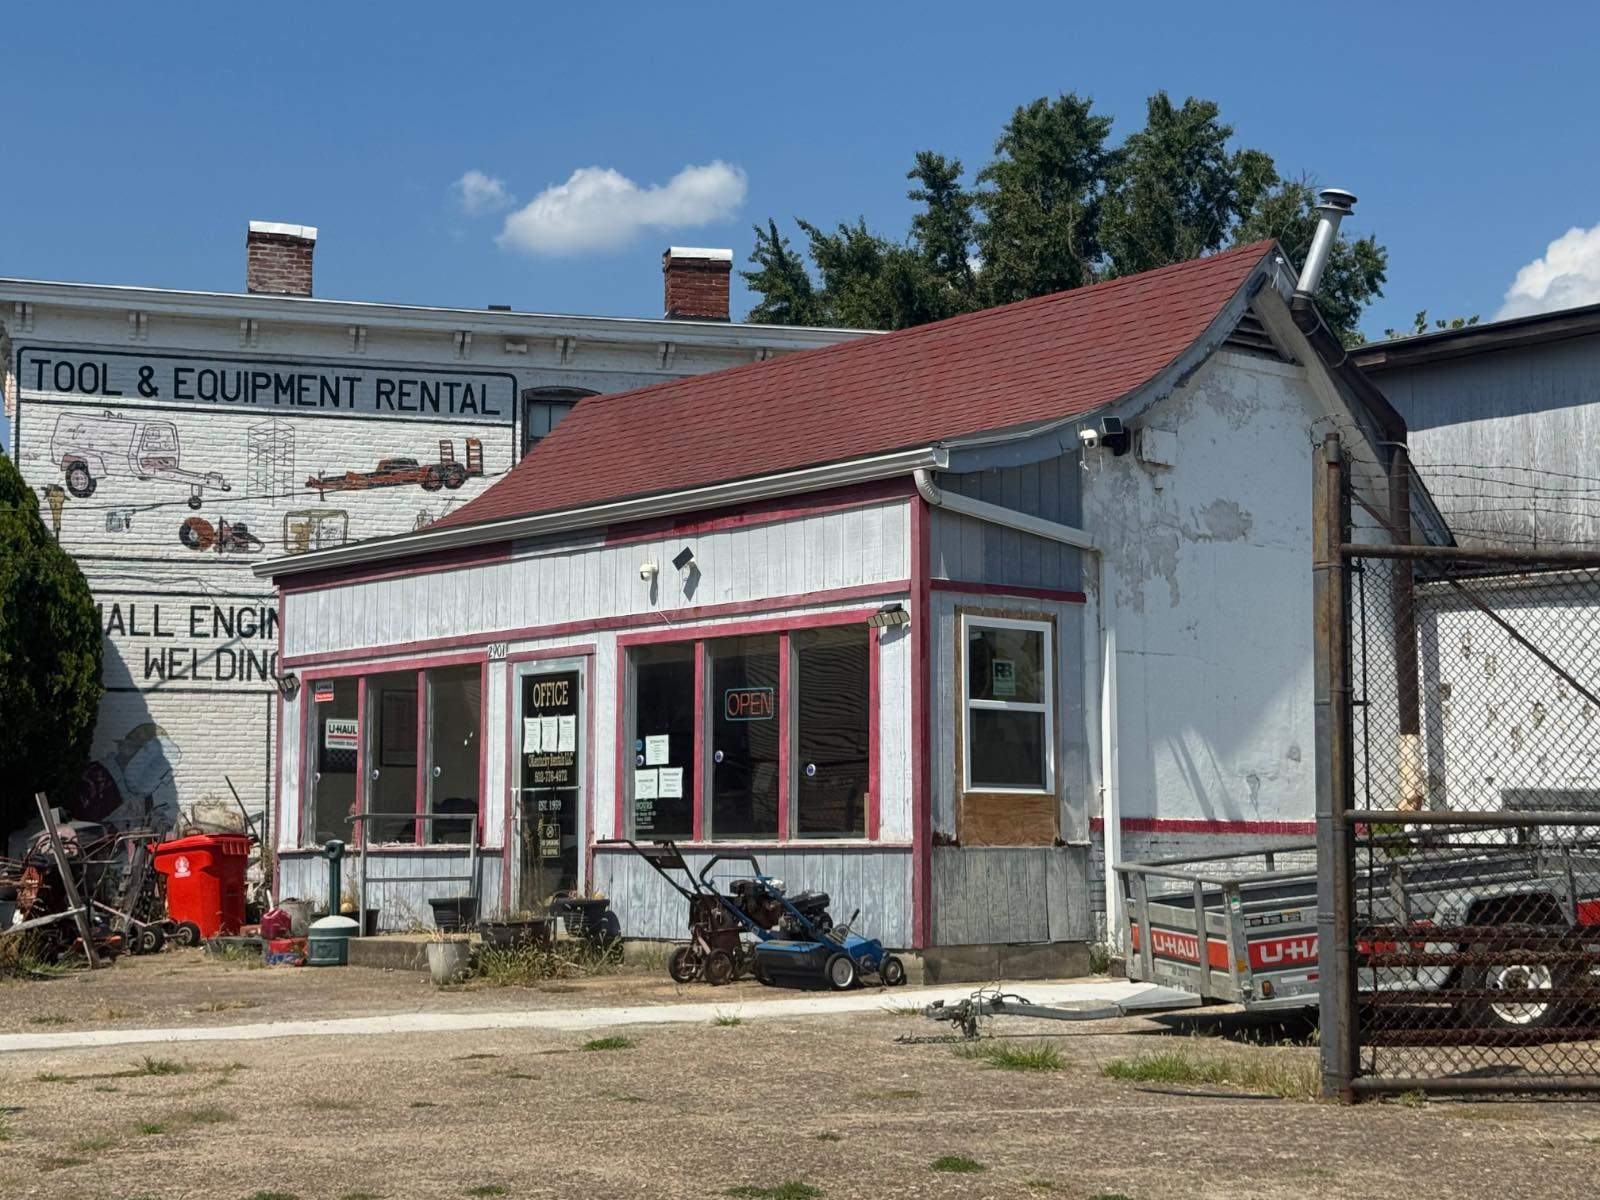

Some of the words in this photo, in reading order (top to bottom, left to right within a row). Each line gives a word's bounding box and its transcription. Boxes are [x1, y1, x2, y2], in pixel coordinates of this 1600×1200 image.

[30, 358, 122, 395] TOOL
[138, 365, 159, 398] &
[174, 367, 362, 409] EQUIPMENT
[376, 378, 500, 416] RENTAL
[533, 681, 569, 708] OFFICE
[727, 692, 772, 716] OPEN
[328, 724, 358, 734] U-HAUL
